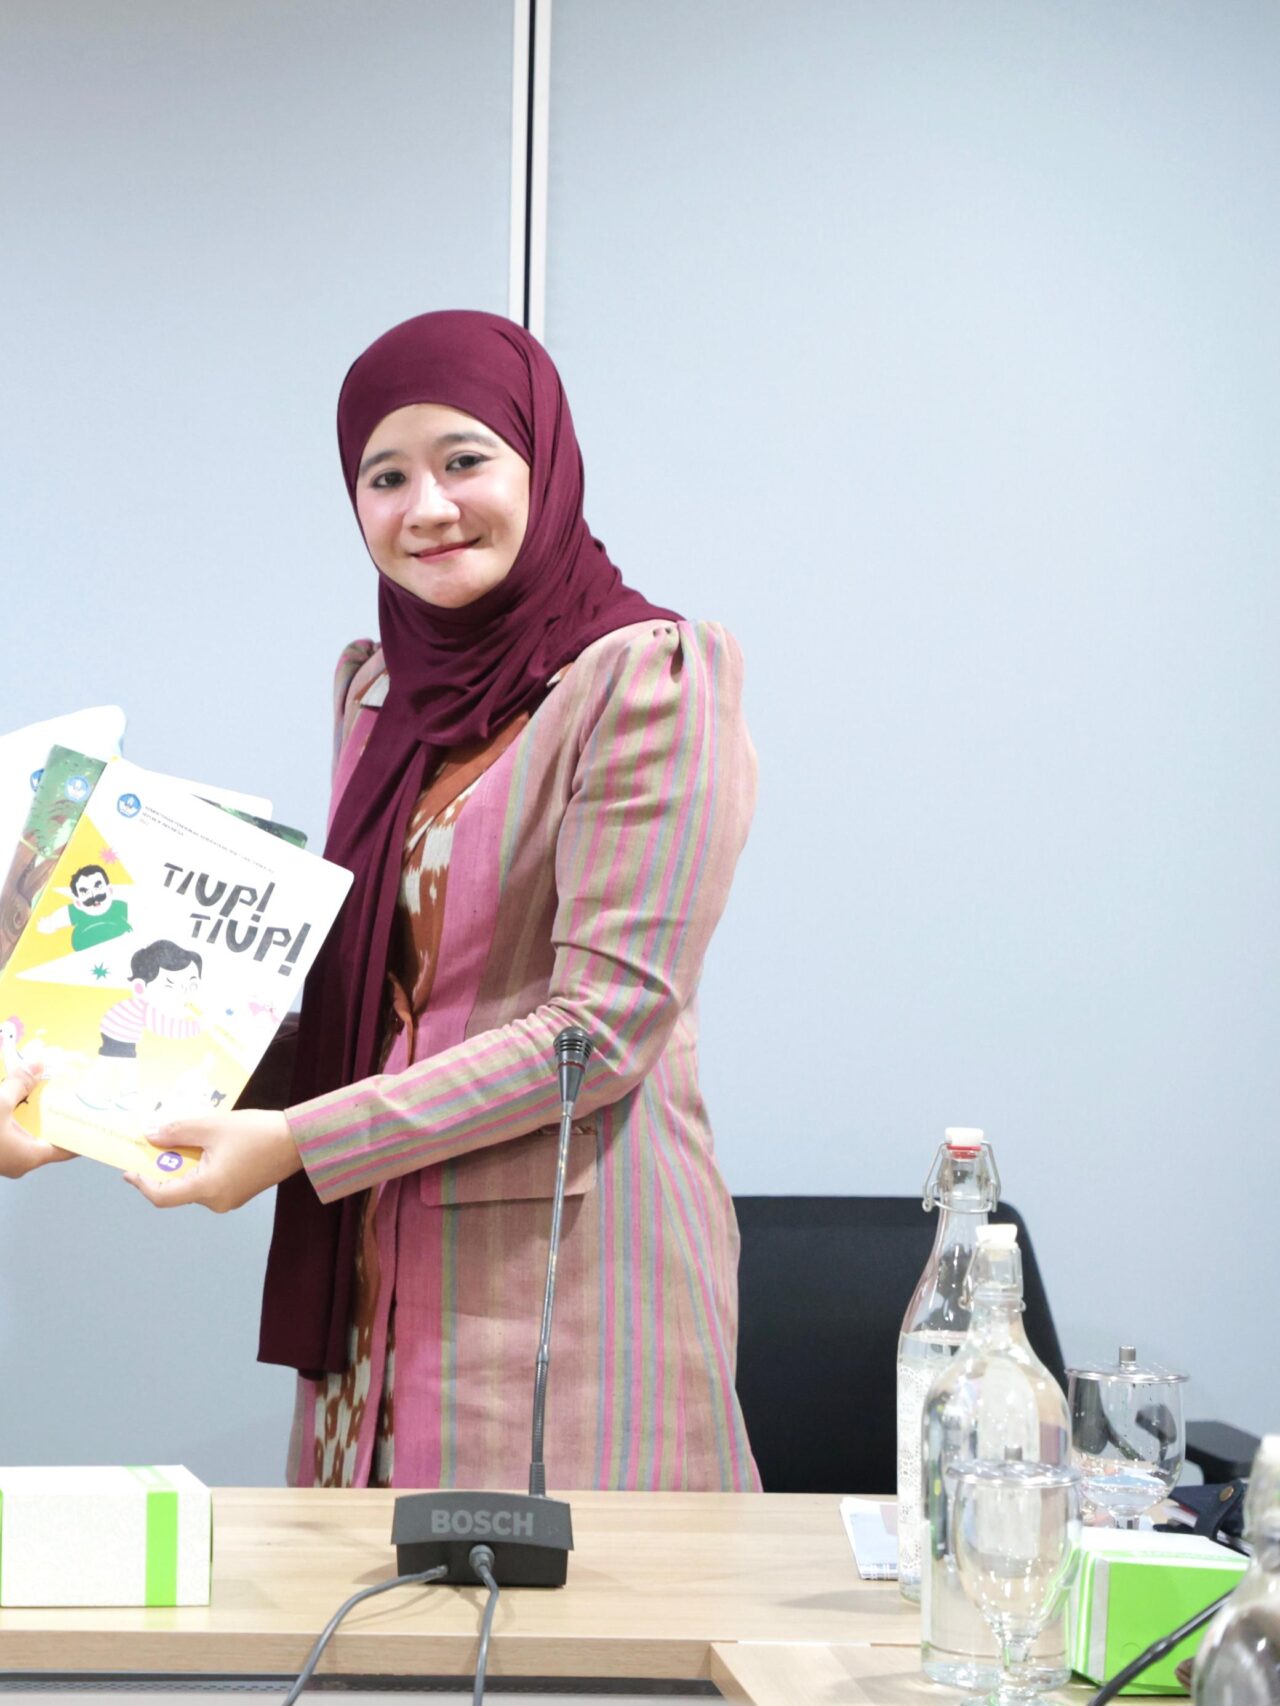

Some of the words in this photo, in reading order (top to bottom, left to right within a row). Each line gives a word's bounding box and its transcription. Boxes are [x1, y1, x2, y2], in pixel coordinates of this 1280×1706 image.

[163, 862, 276, 923] TIUP!
[189, 913, 312, 977] TIUP!
[160, 1155, 179, 1168] B2
[431, 1509, 534, 1536] BOSCH
